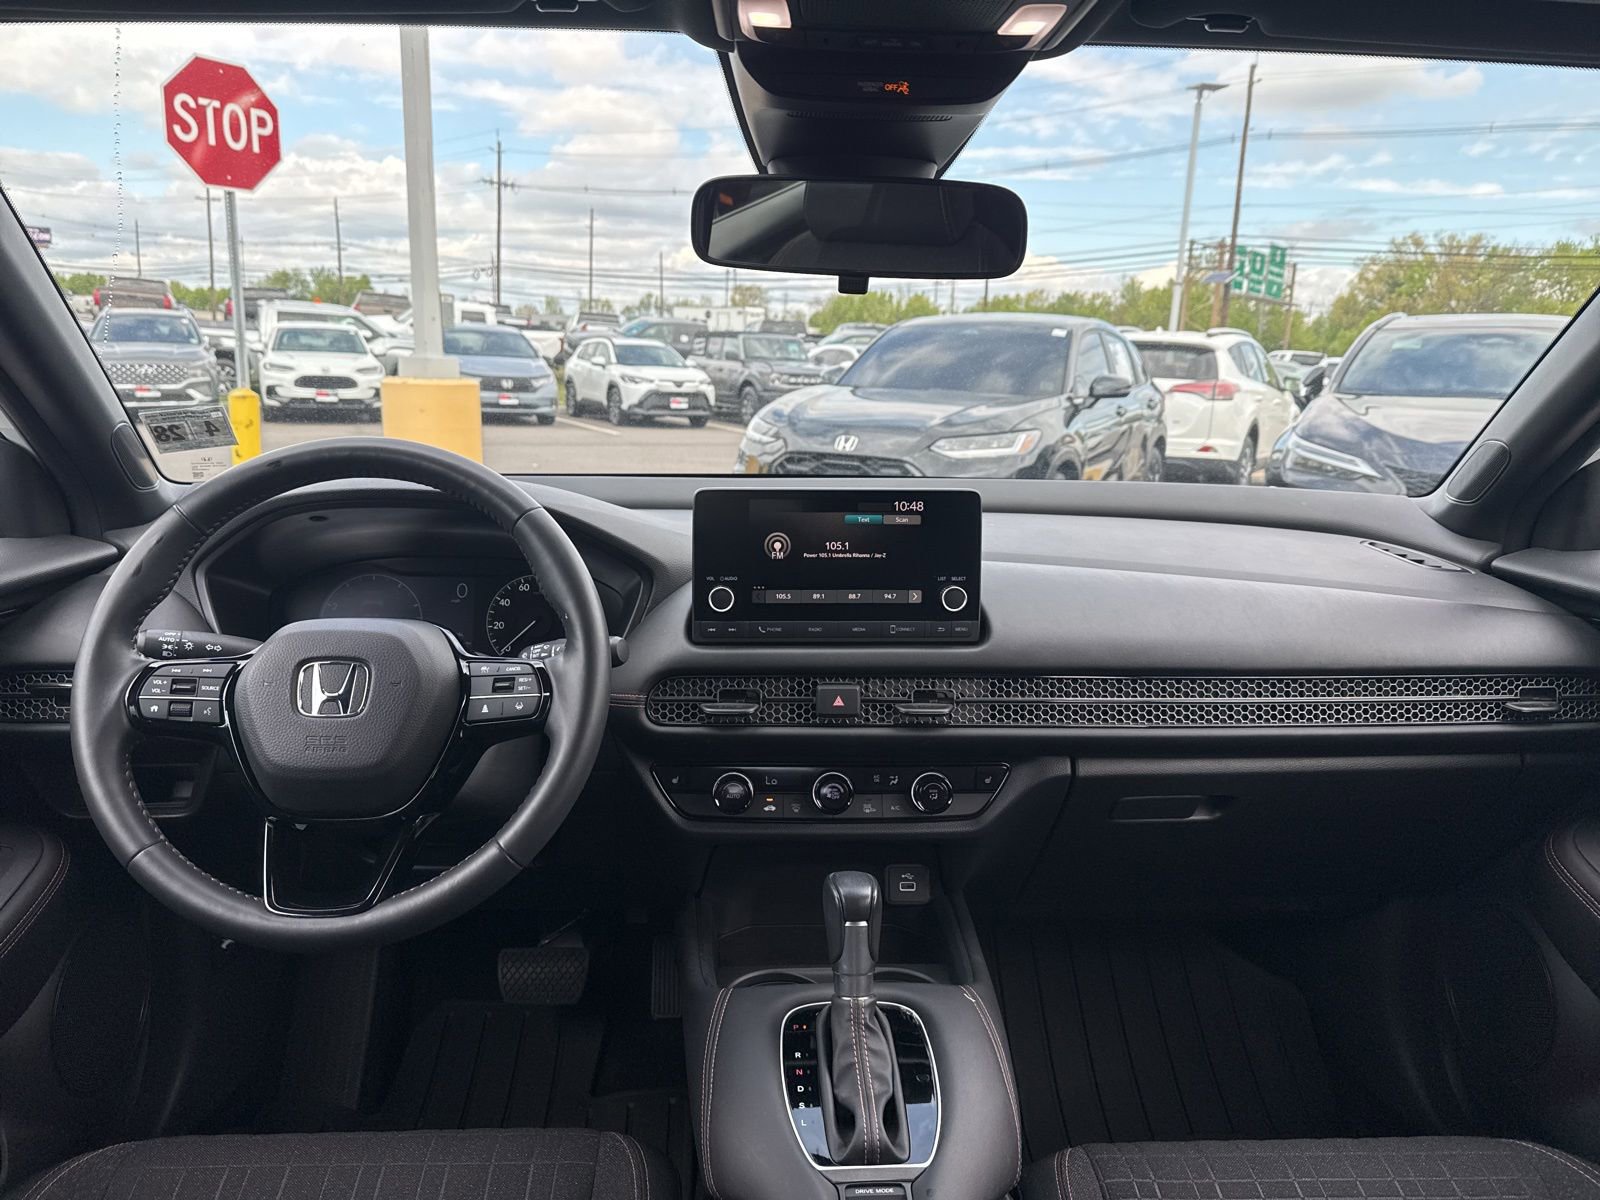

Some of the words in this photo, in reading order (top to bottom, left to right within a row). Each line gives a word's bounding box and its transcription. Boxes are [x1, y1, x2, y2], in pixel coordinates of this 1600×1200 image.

[884, 83, 898, 91] OFF
[172, 92, 274, 154] STOP
[894, 501, 924, 511] 10:48
[825, 541, 849, 550] 105.1
[771, 551, 784, 560] FM
[518, 583, 530, 591] 60
[499, 598, 510, 607] 40
[493, 621, 505, 629] 20
[765, 775, 777, 785] Lo
[794, 1051, 802, 1059] R
[795, 1068, 804, 1076] N
[797, 1085, 805, 1093] D
